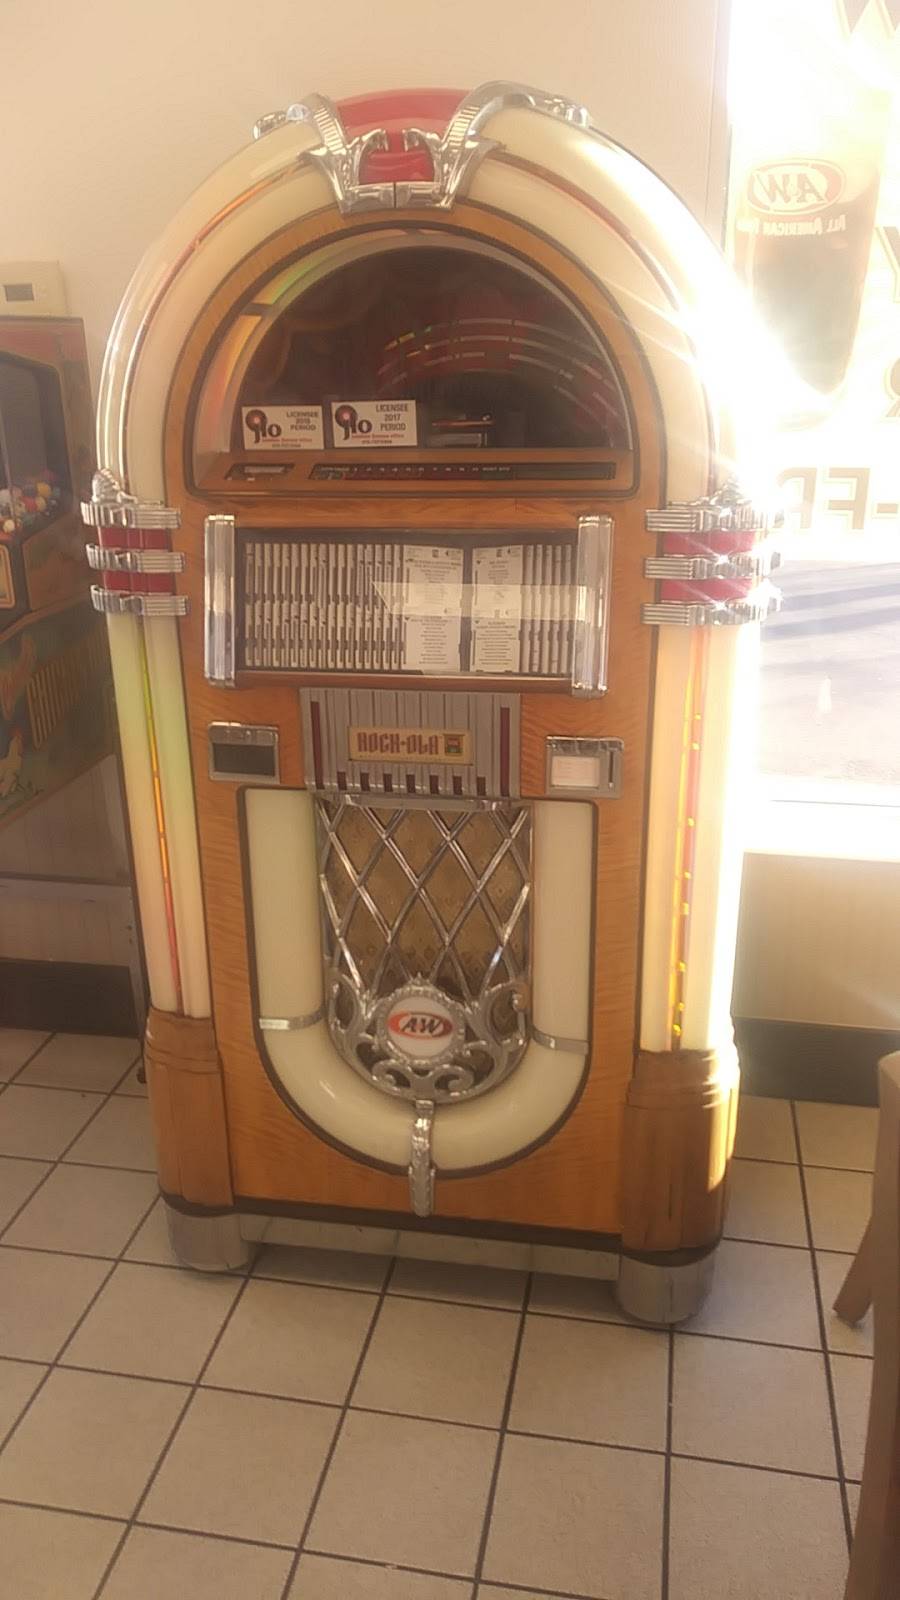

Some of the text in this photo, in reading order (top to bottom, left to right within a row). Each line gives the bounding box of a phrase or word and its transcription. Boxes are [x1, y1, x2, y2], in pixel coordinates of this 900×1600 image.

[375, 403, 409, 412] LICENSEE
[385, 413, 401, 421] 2017
[290, 424, 317, 432] PERIOD
[380, 423, 406, 432] PERIOD
